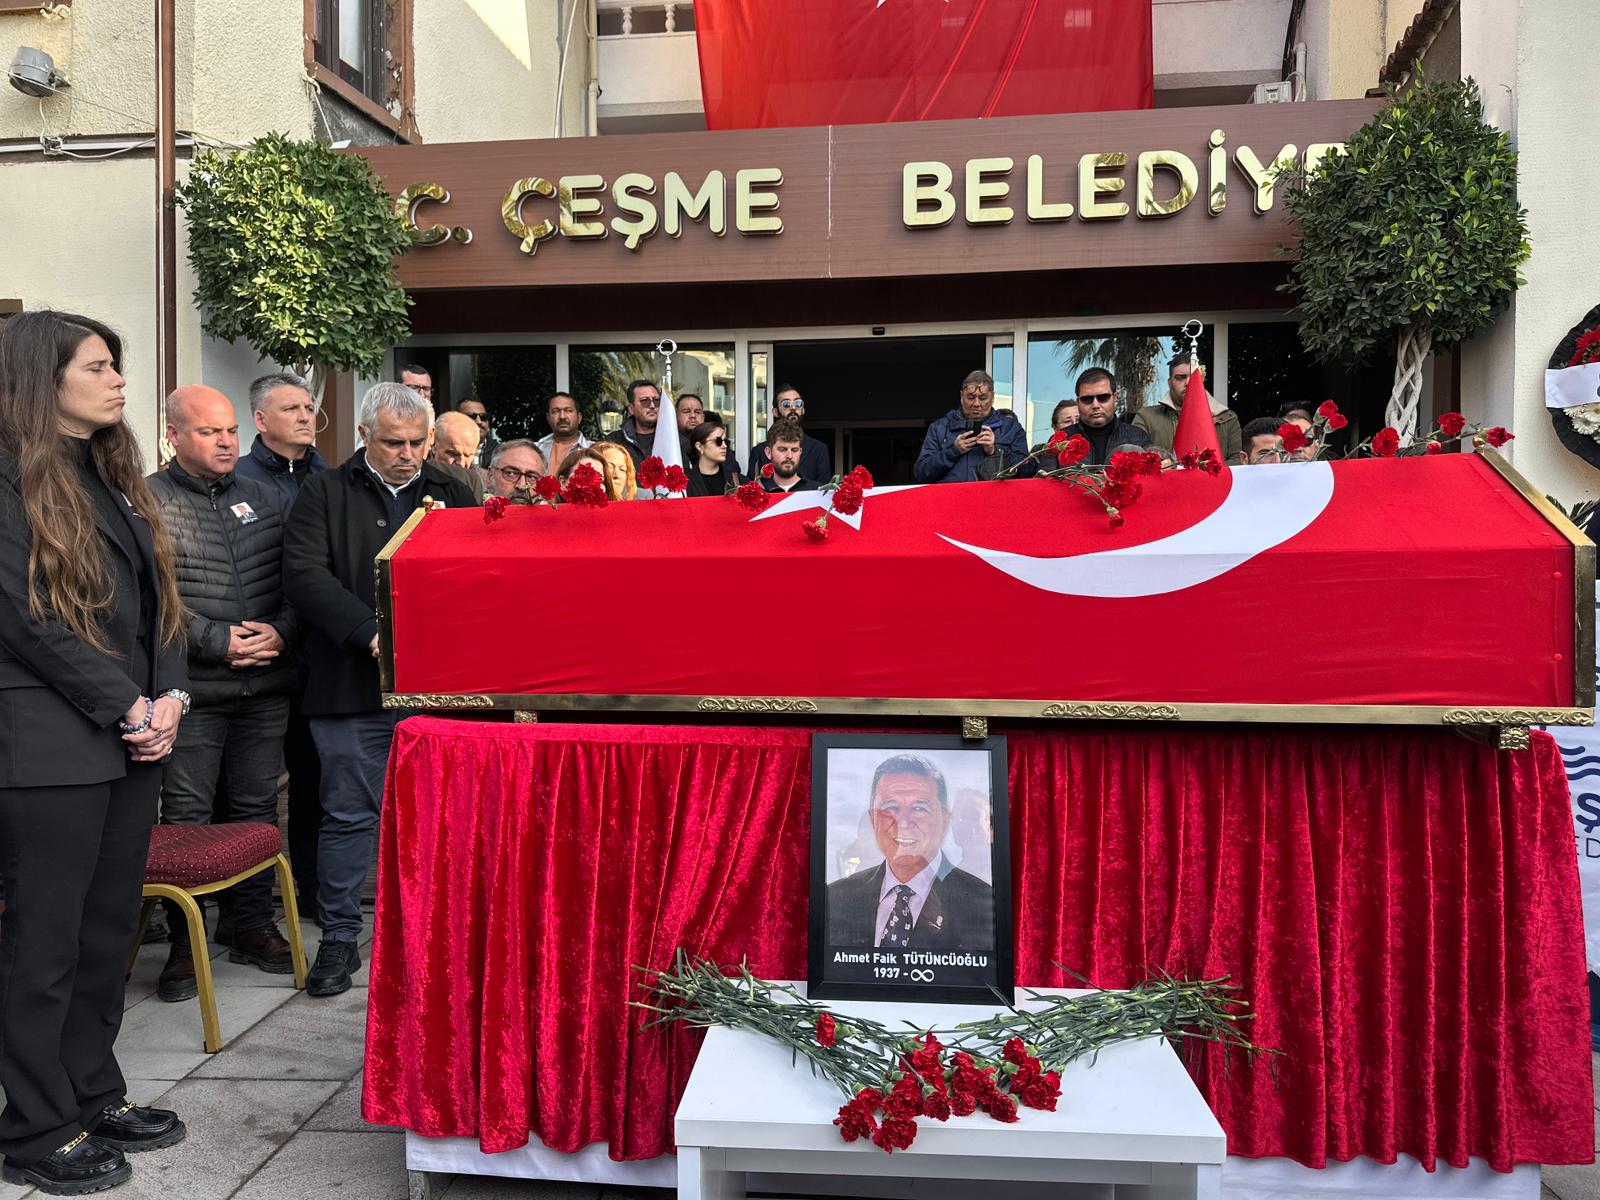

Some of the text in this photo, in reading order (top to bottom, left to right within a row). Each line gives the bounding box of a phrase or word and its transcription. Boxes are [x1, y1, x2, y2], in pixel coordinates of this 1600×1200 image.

[501, 167, 785, 256] ÇEŞME
[833, 951, 988, 967] Ahmet Faik TÜTÜNCÜOĞLU
[873, 967, 900, 979] 1937
